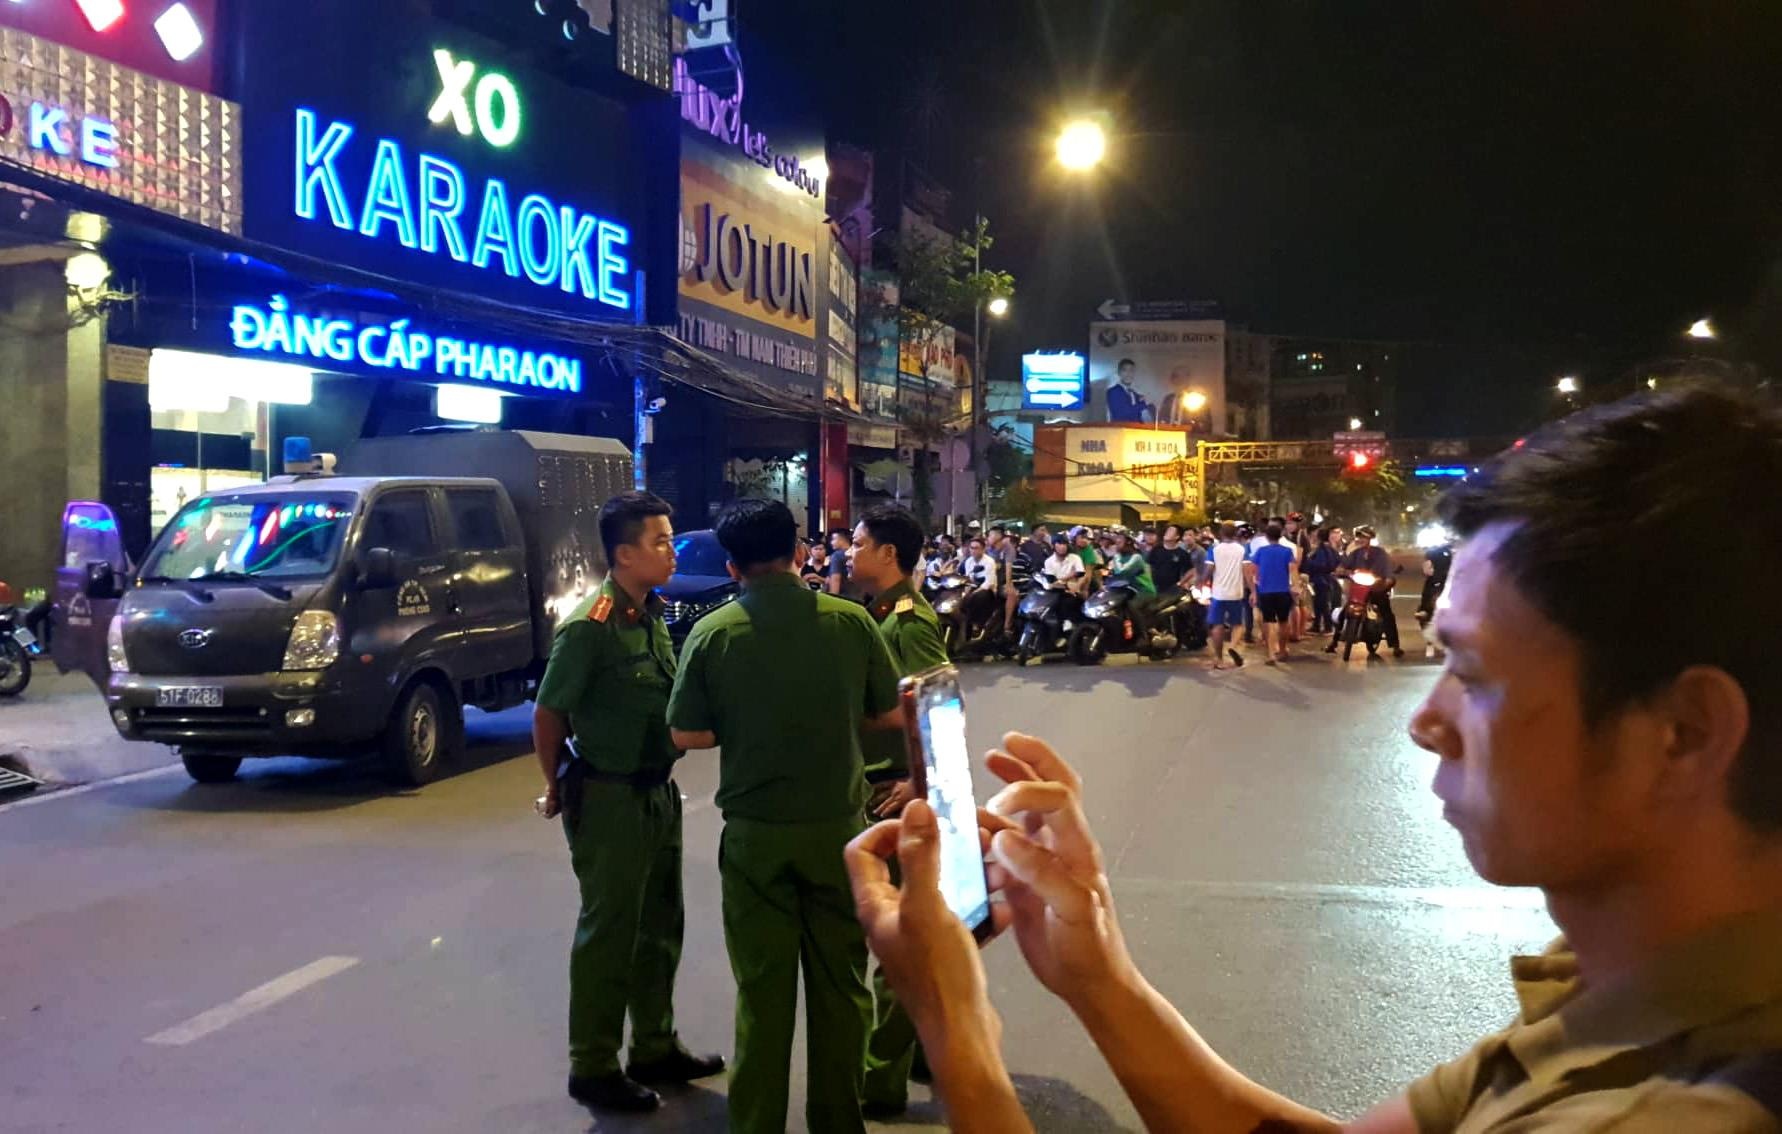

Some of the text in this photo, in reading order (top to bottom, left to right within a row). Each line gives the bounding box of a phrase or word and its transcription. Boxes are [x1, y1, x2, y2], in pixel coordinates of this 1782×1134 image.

[427, 48, 522, 148] XO
[294, 107, 632, 309] KARAOKE
[696, 202, 816, 320] JOTUN
[357, 318, 431, 370] CẤP
[435, 337, 581, 393] PHARAON
